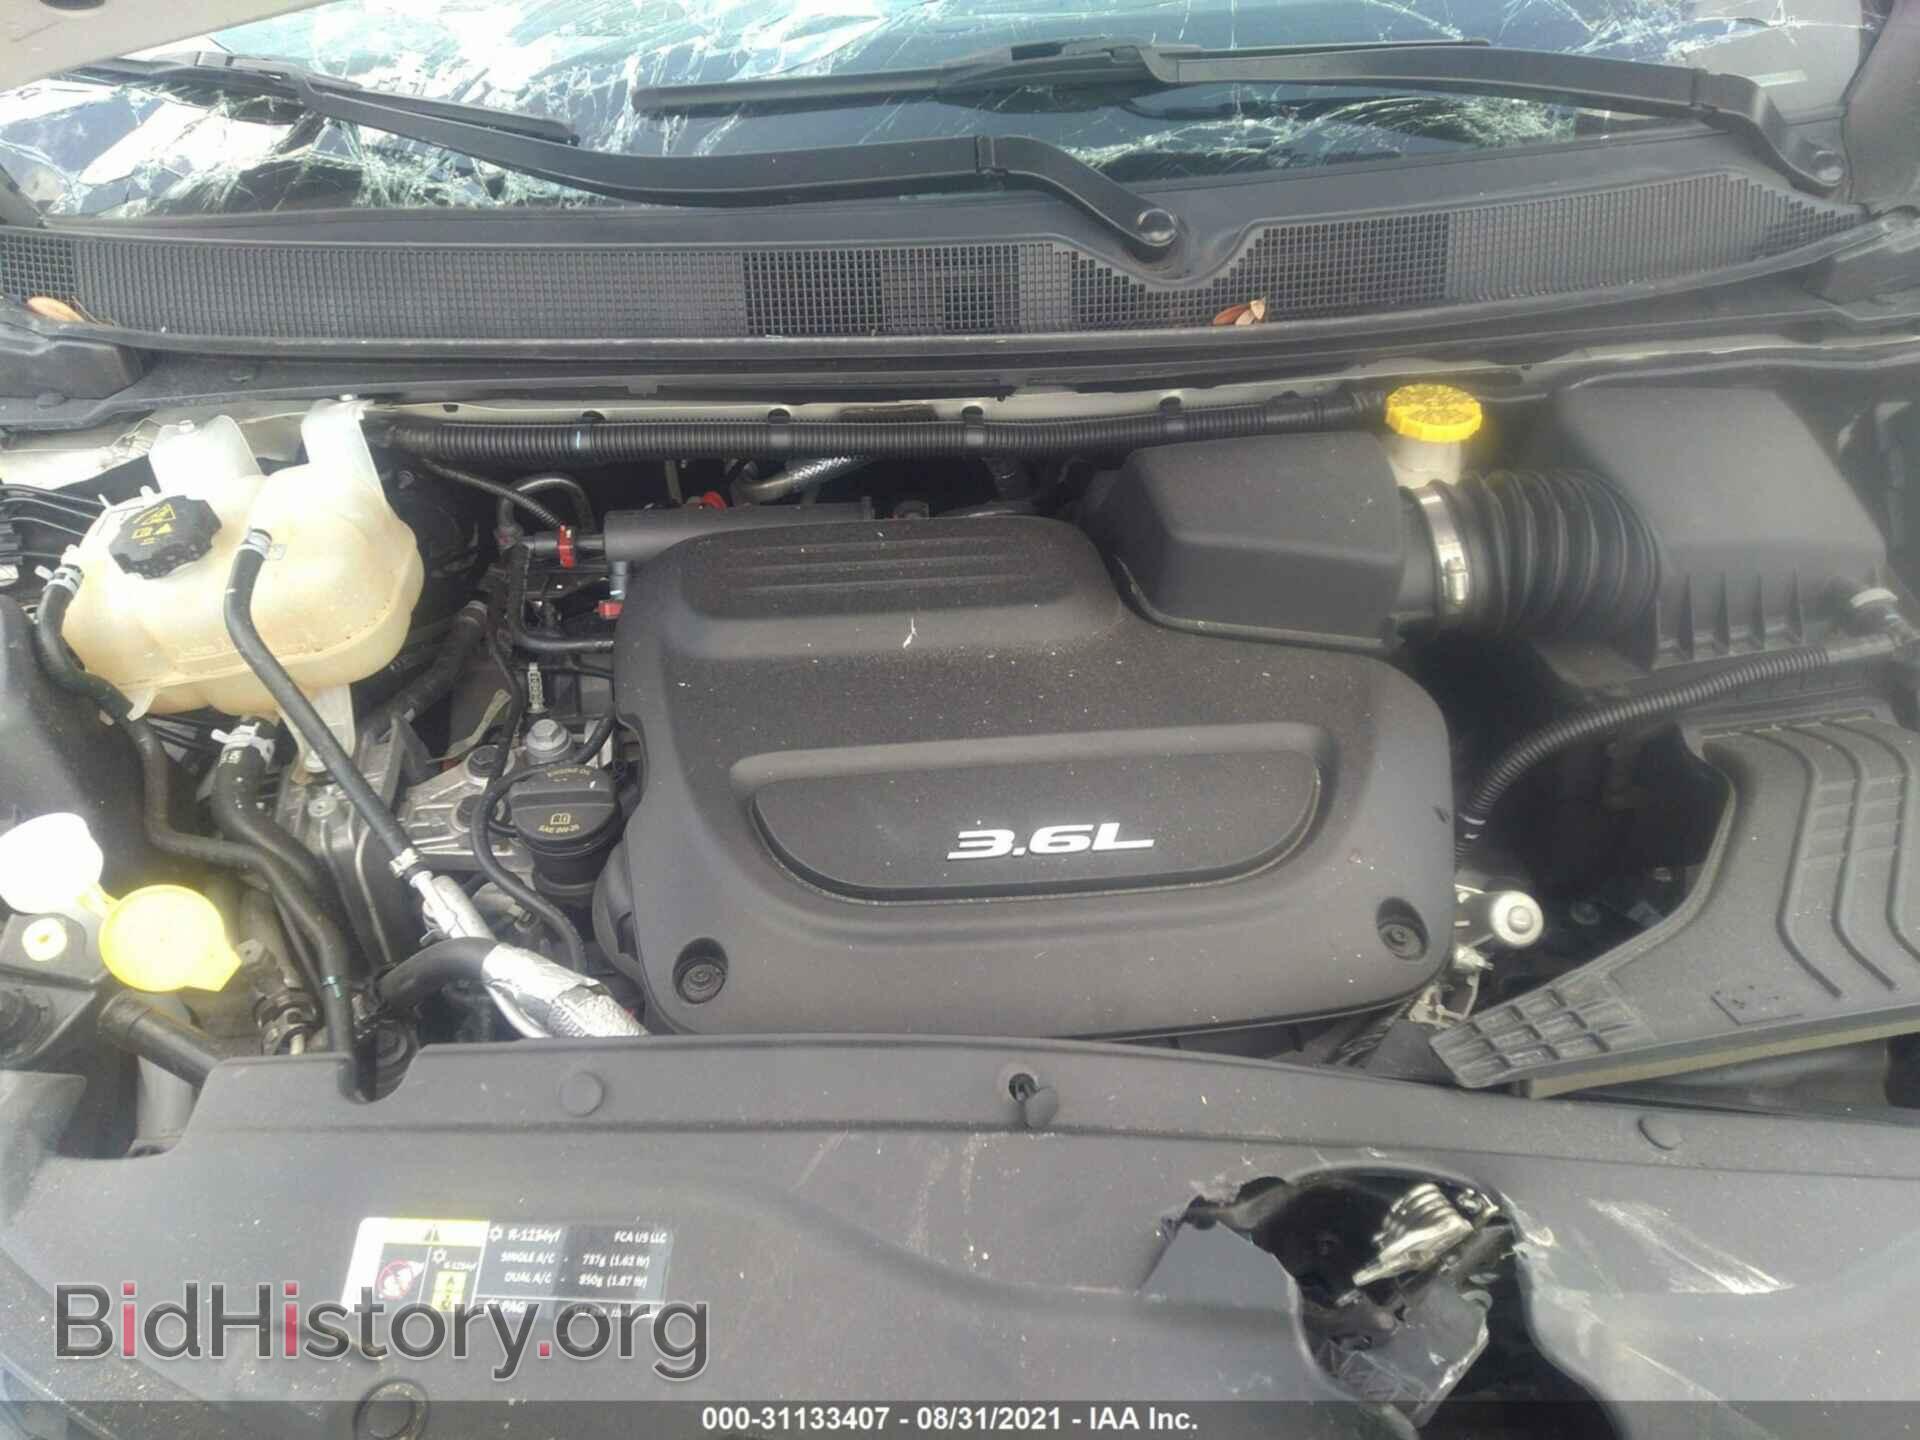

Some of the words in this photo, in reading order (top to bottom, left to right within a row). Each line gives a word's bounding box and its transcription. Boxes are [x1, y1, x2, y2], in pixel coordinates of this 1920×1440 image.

[946, 821, 1155, 859] 3.6L
[614, 1229, 633, 1243] FCA
[650, 1231, 668, 1244] LLC
